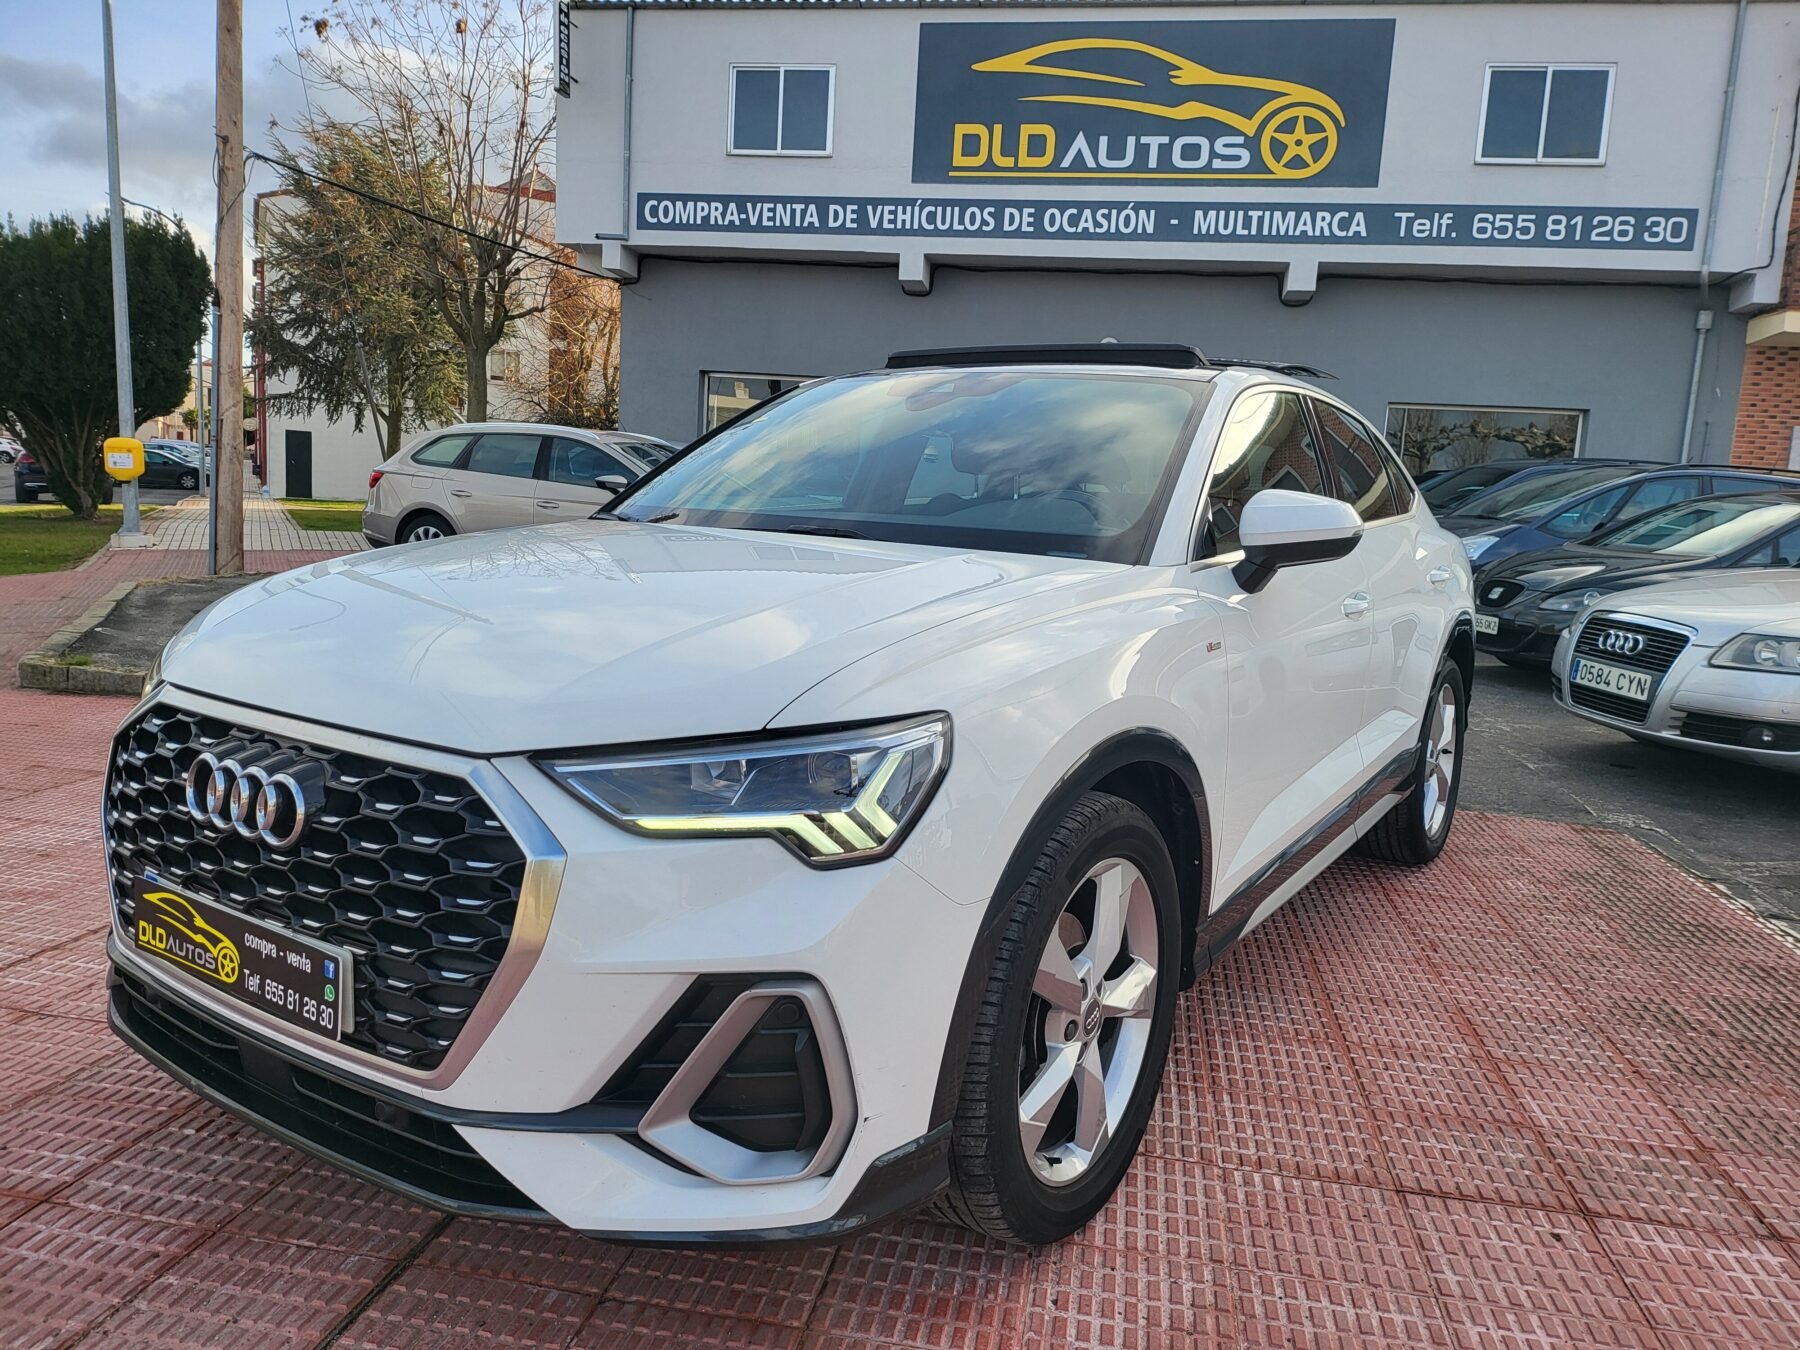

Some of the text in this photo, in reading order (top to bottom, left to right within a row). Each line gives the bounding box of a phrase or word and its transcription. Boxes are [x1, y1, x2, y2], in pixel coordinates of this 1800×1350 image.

[952, 123, 1251, 169] DLD AUTOS
[644, 199, 819, 227] COMPRA-VENTA
[828, 205, 858, 228] DE
[866, 199, 995, 231] VEHÍCULOS
[1003, 207, 1035, 232] DE
[1043, 202, 1156, 234] OCASIÓN
[1193, 210, 1367, 237] MULTIMARCA
[1394, 212, 1457, 238] Telf.
[1472, 213, 1536, 240] 655
[1643, 217, 1688, 243] 30
[1579, 663, 1648, 696] 0584 CYN
[139, 919, 215, 970] DLD AUTOS
[244, 932, 277, 959] compra
[286, 950, 311, 973] venta
[243, 968, 334, 1029] Telf. 655 81 26 30
